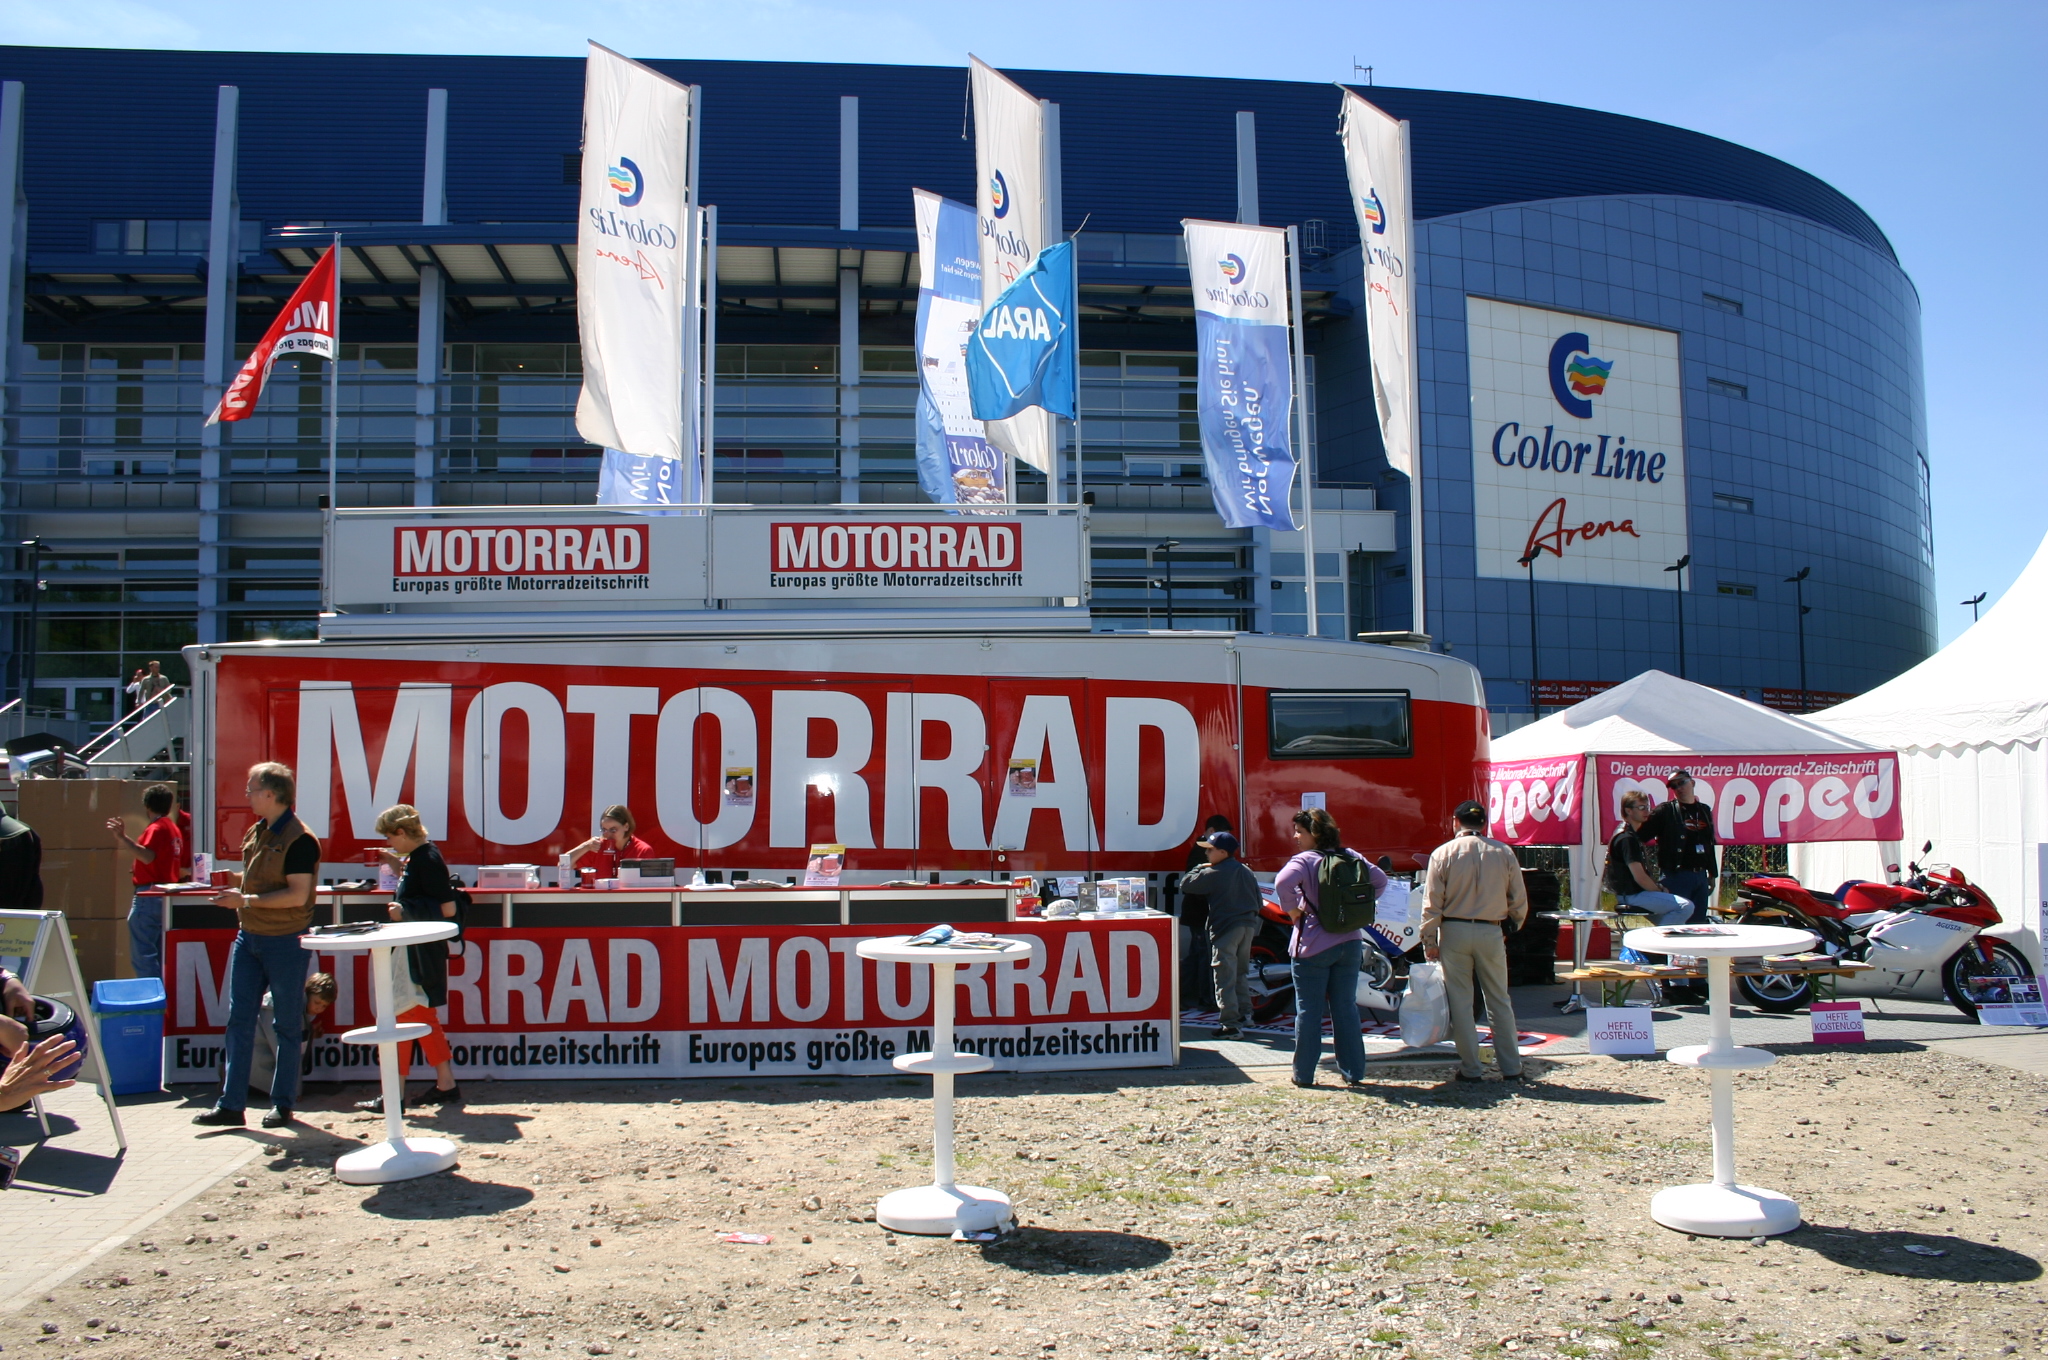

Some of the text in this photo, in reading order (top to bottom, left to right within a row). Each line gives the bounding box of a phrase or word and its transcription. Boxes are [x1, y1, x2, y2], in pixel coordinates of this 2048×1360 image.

[778, 526, 1015, 569] MOTORRAD
[1522, 497, 1641, 567] Arena
[401, 528, 642, 573] MOTORRAD
[393, 575, 650, 595] Europas größte Motorradzeitschrift
[770, 571, 1023, 590] Europas größte Motorradzeitschrift
[299, 680, 1201, 854] MOTORRAD
[1610, 761, 1634, 775] Die
[1736, 760, 1876, 777] Motorrad-Zeitschrift
[1487, 760, 1578, 839] pped
[176, 938, 661, 1028] MTRRAD
[1608, 1021, 1634, 1031] HEFTE
[1814, 1021, 1862, 1032] KOSTENLOS
[1826, 1012, 1849, 1022] HEFTE
[689, 1034, 796, 1071] Europas
[807, 1030, 896, 1070] größte
[906, 1021, 1160, 1058] Mtorradzeitschrift
[1594, 1031, 1649, 1041] KOSTENLOS
